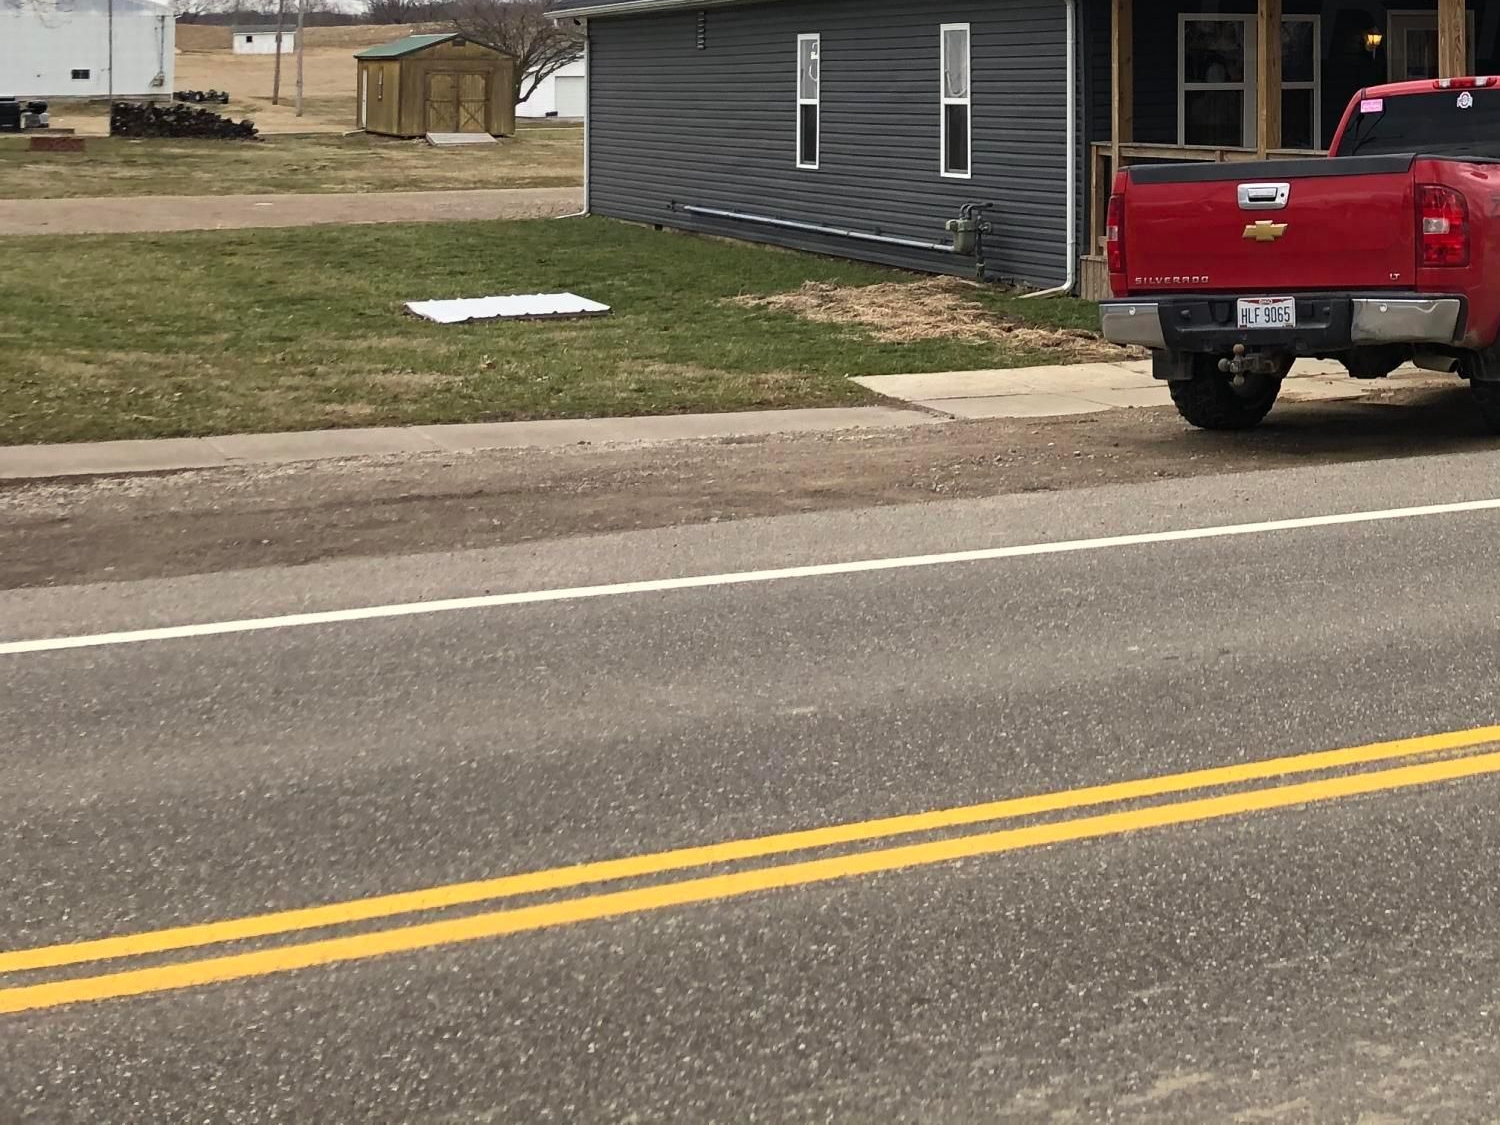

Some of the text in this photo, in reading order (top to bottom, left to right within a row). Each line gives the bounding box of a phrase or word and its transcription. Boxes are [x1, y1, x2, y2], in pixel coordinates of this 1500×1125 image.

[1135, 275, 1209, 285] SILVERADO
[1389, 272, 1401, 281] LT
[1241, 306, 1291, 324] HLF 9065
